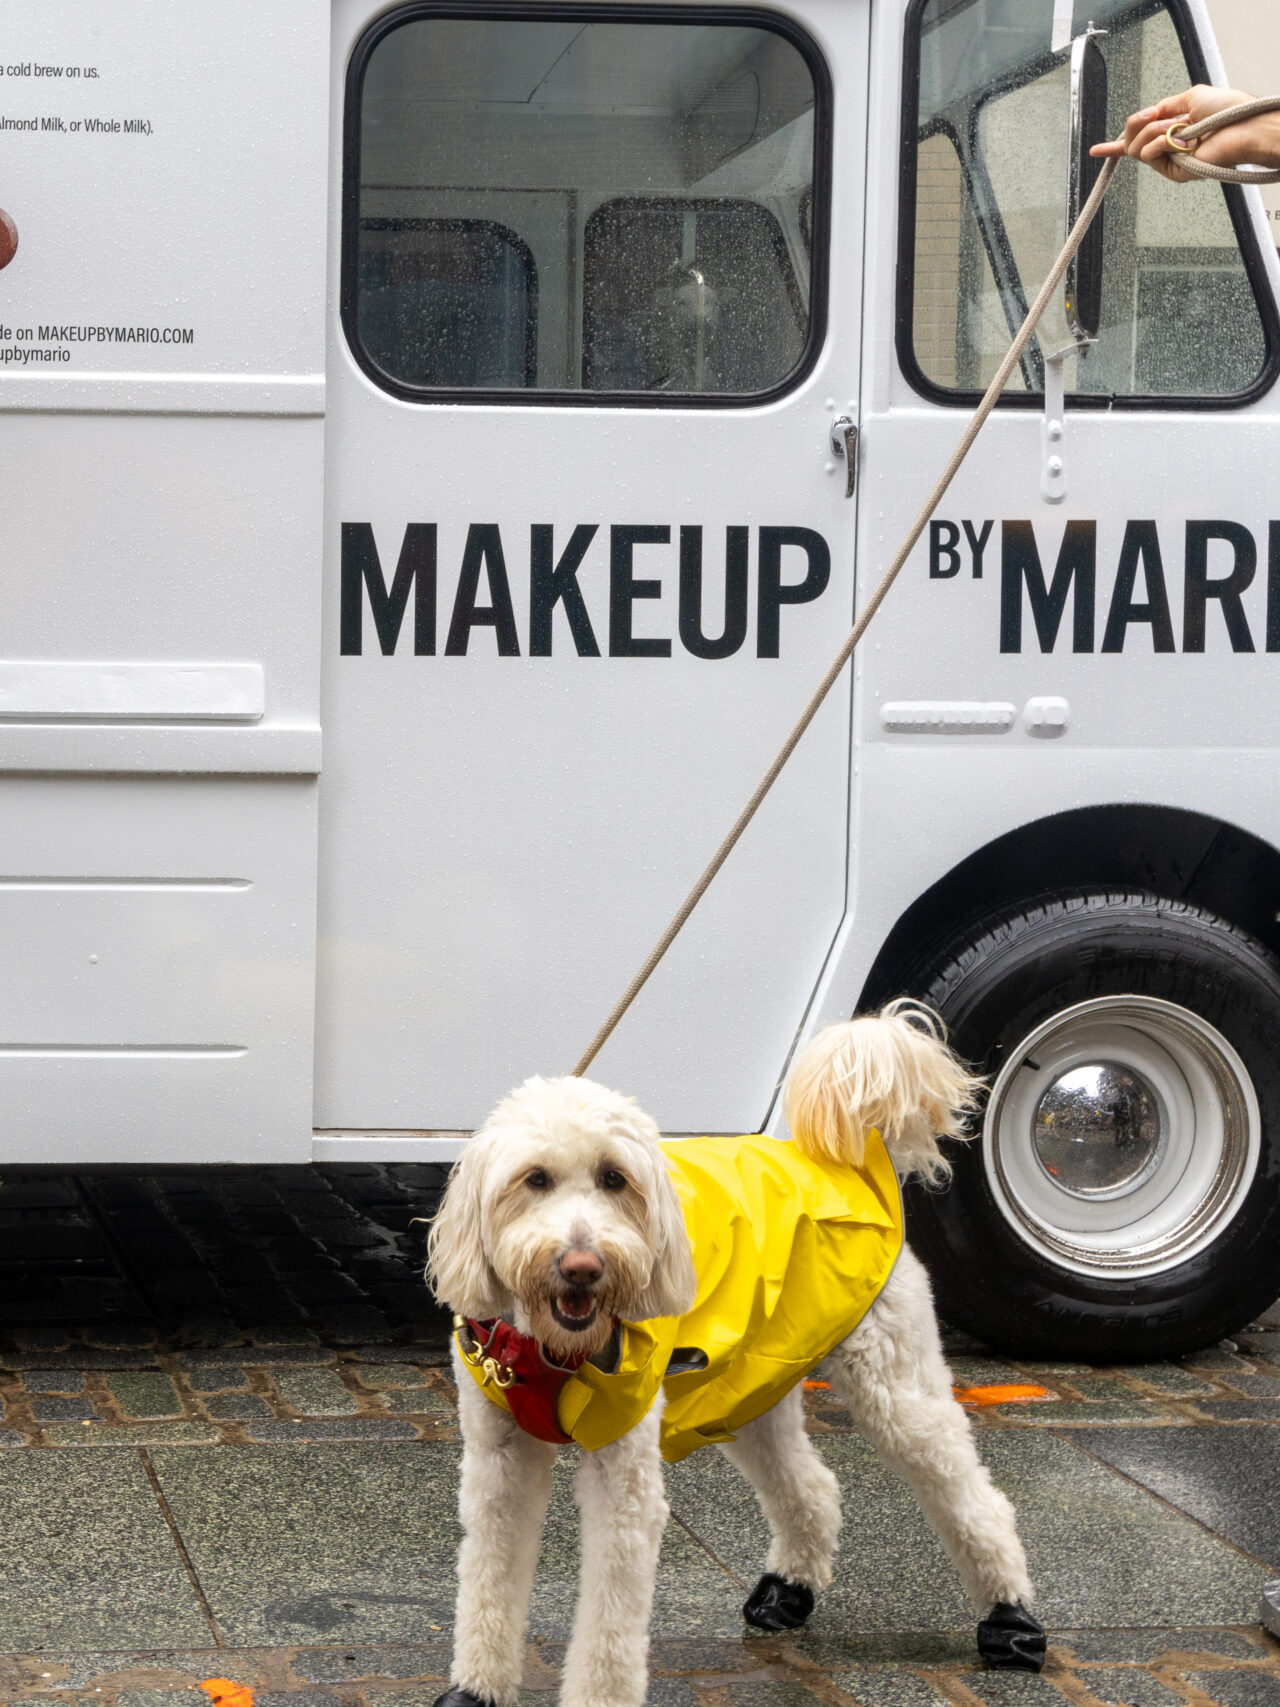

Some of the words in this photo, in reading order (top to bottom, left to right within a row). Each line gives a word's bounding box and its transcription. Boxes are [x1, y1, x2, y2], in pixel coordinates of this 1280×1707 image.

[7, 63, 31, 76] cold
[34, 63, 63, 77] brew
[66, 67, 80, 77] on
[84, 68, 99, 78] us.
[42, 117, 67, 133] Milk,
[70, 122, 82, 131] or
[84, 118, 120, 132] Whole
[124, 120, 153, 136] Milk).
[15, 329, 33, 341] on
[38, 326, 193, 343] MAKEUPBYMARIO.COM
[340, 522, 831, 660] MAKEUP
[929, 520, 994, 579] BY
[999, 520, 1280, 654] MARI
